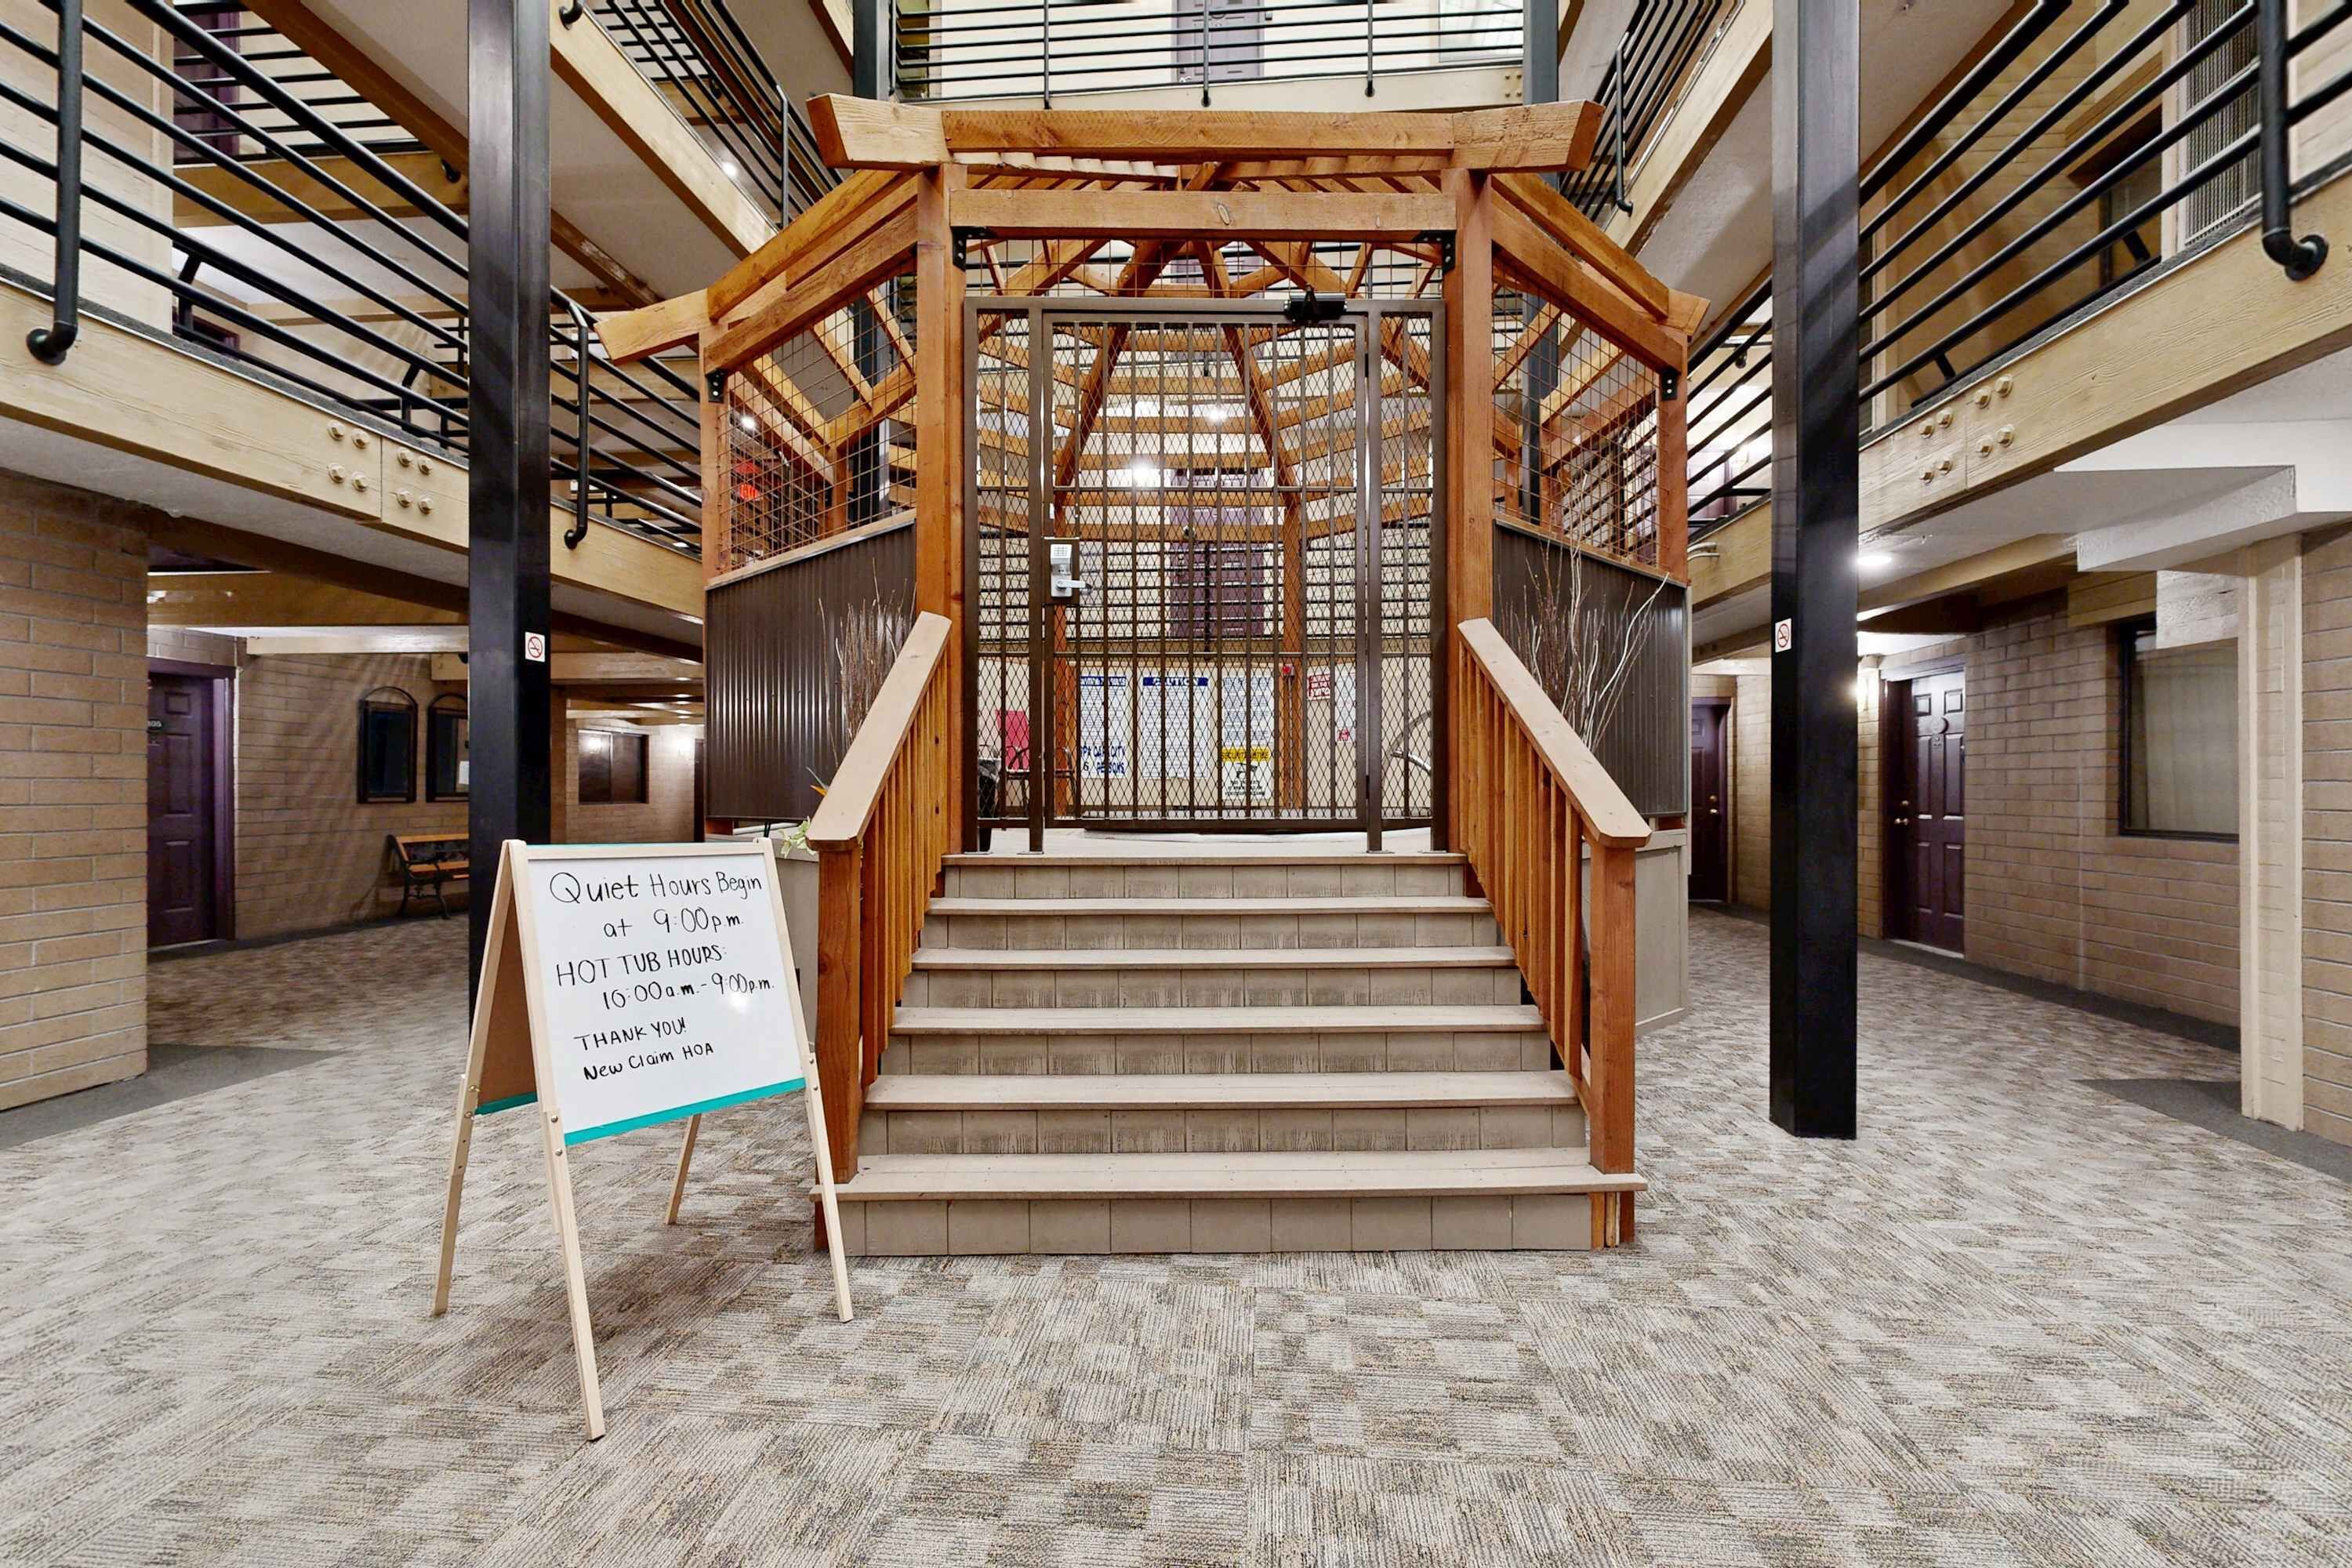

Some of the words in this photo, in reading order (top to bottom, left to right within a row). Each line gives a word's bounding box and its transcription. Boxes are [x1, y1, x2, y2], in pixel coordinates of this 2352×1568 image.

[550, 872, 640, 904] Quiet
[649, 873, 712, 898] Hours
[715, 871, 762, 900] Begin
[603, 917, 633, 938] at
[556, 957, 610, 987] HOT
[616, 951, 662, 975] TUB
[573, 1025, 648, 1051] THANK
[650, 1016, 687, 1039] YOU!
[583, 1062, 623, 1080] New
[628, 1051, 675, 1069] Claim
[681, 1042, 714, 1061] HOA
